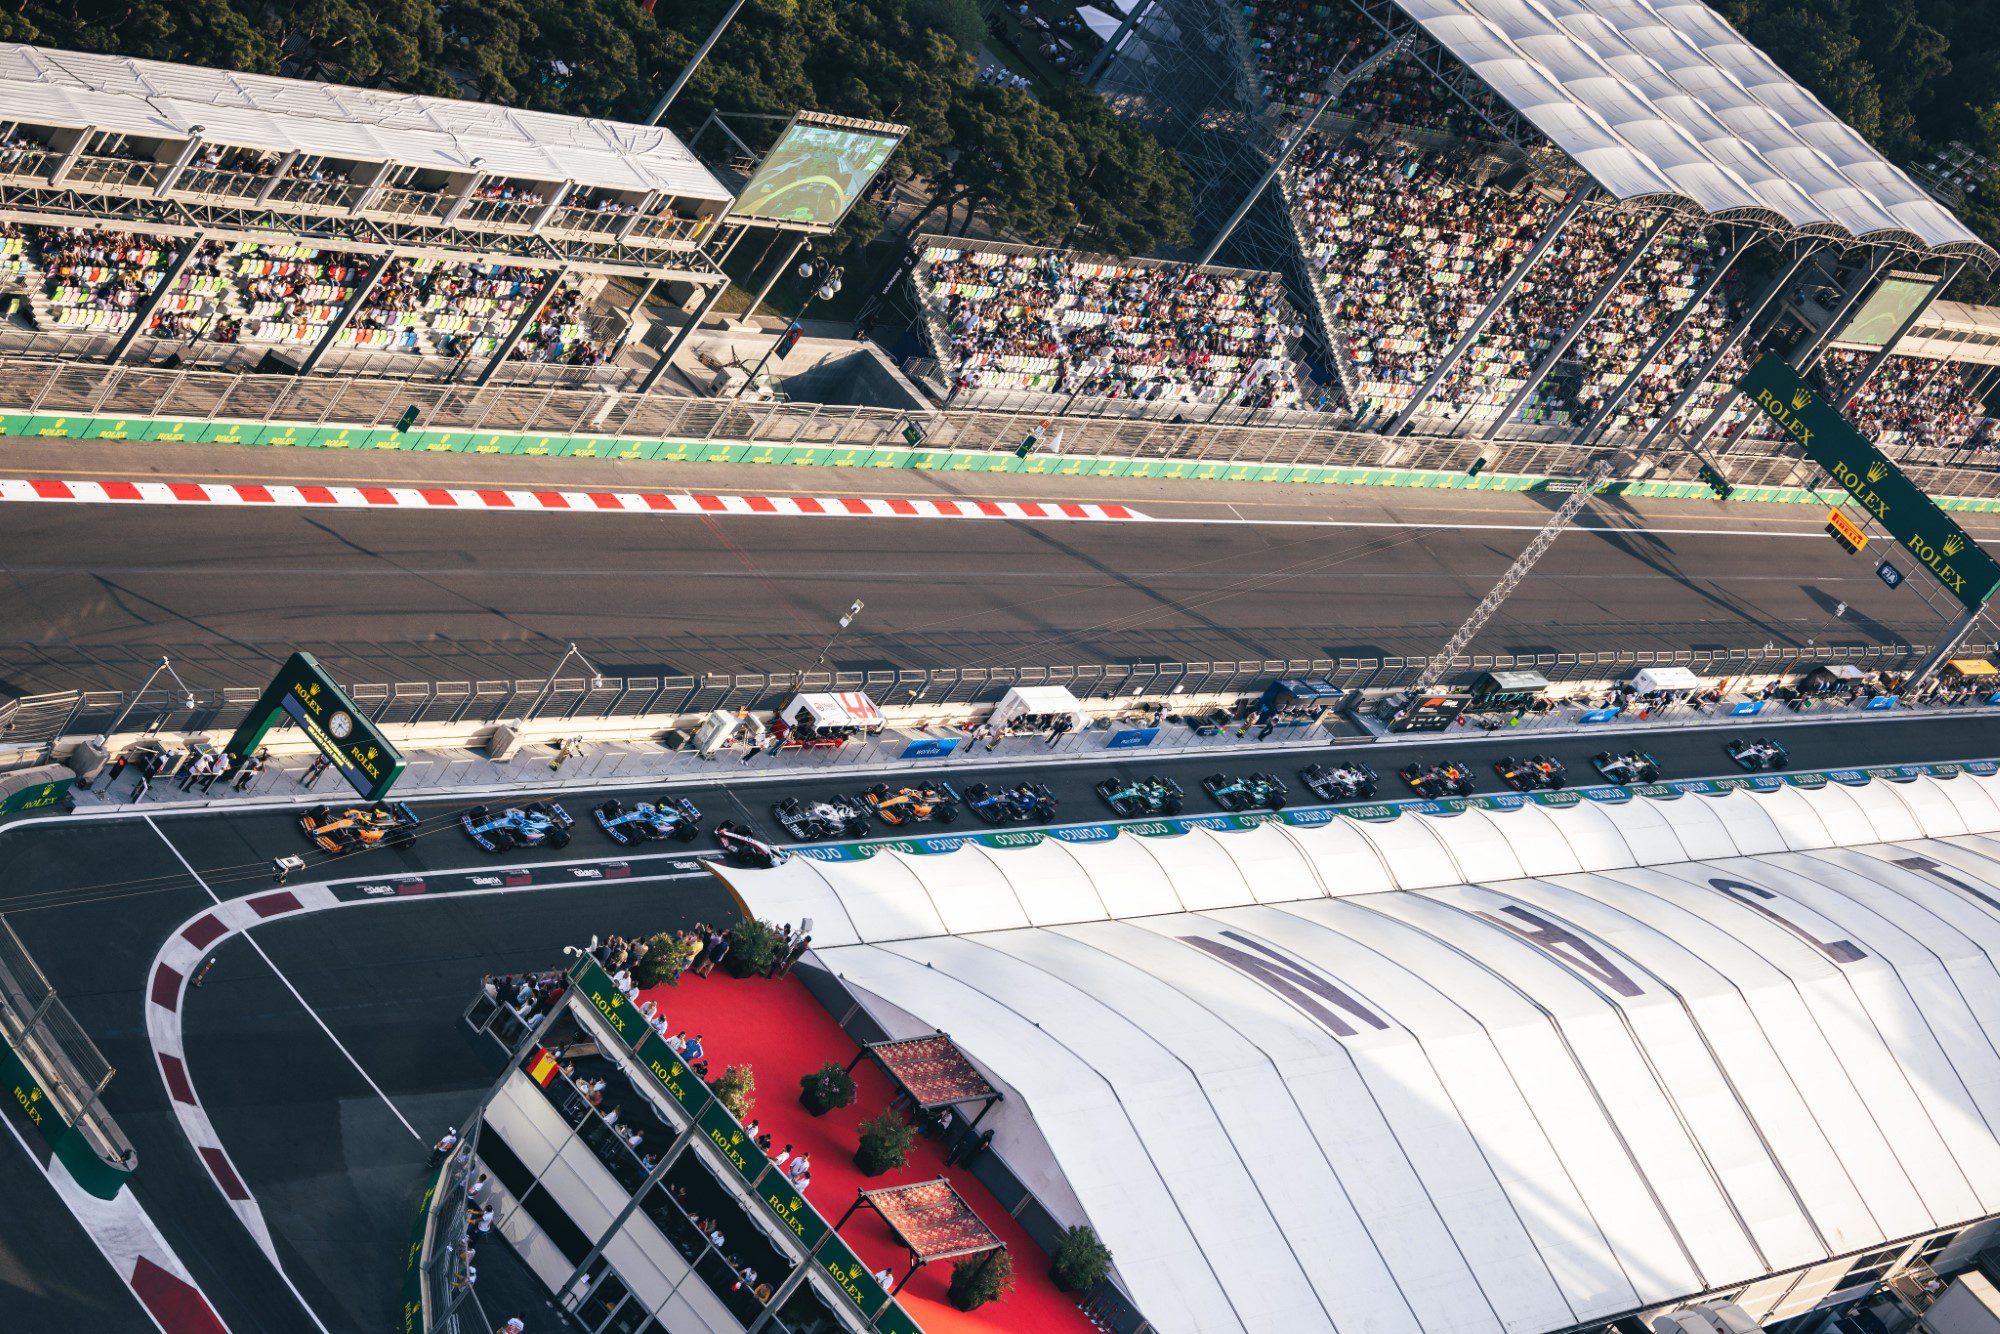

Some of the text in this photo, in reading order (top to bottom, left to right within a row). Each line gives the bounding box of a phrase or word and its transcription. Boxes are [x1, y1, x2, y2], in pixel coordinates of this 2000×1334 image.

[1756, 388, 1816, 447] ROLEX
[1832, 460, 1891, 520] ROLEX
[1832, 512, 1863, 545] PIRELLI
[1881, 567, 1897, 584] FIA
[1908, 534, 1967, 594] ROLEX
[293, 682, 322, 716] ROLEX
[351, 747, 380, 779] ROLEX
[1348, 805, 1391, 818] aramco
[1588, 788, 1625, 799] aramco
[1059, 827, 1109, 840] aramco
[591, 991, 626, 1032] ROLEX
[650, 1060, 687, 1101] ROLEX
[13, 1085, 43, 1126] ROLEX
[710, 1128, 747, 1171] ROLEX
[768, 1194, 805, 1237] ROLEX
[828, 1262, 865, 1304] ROLEX
